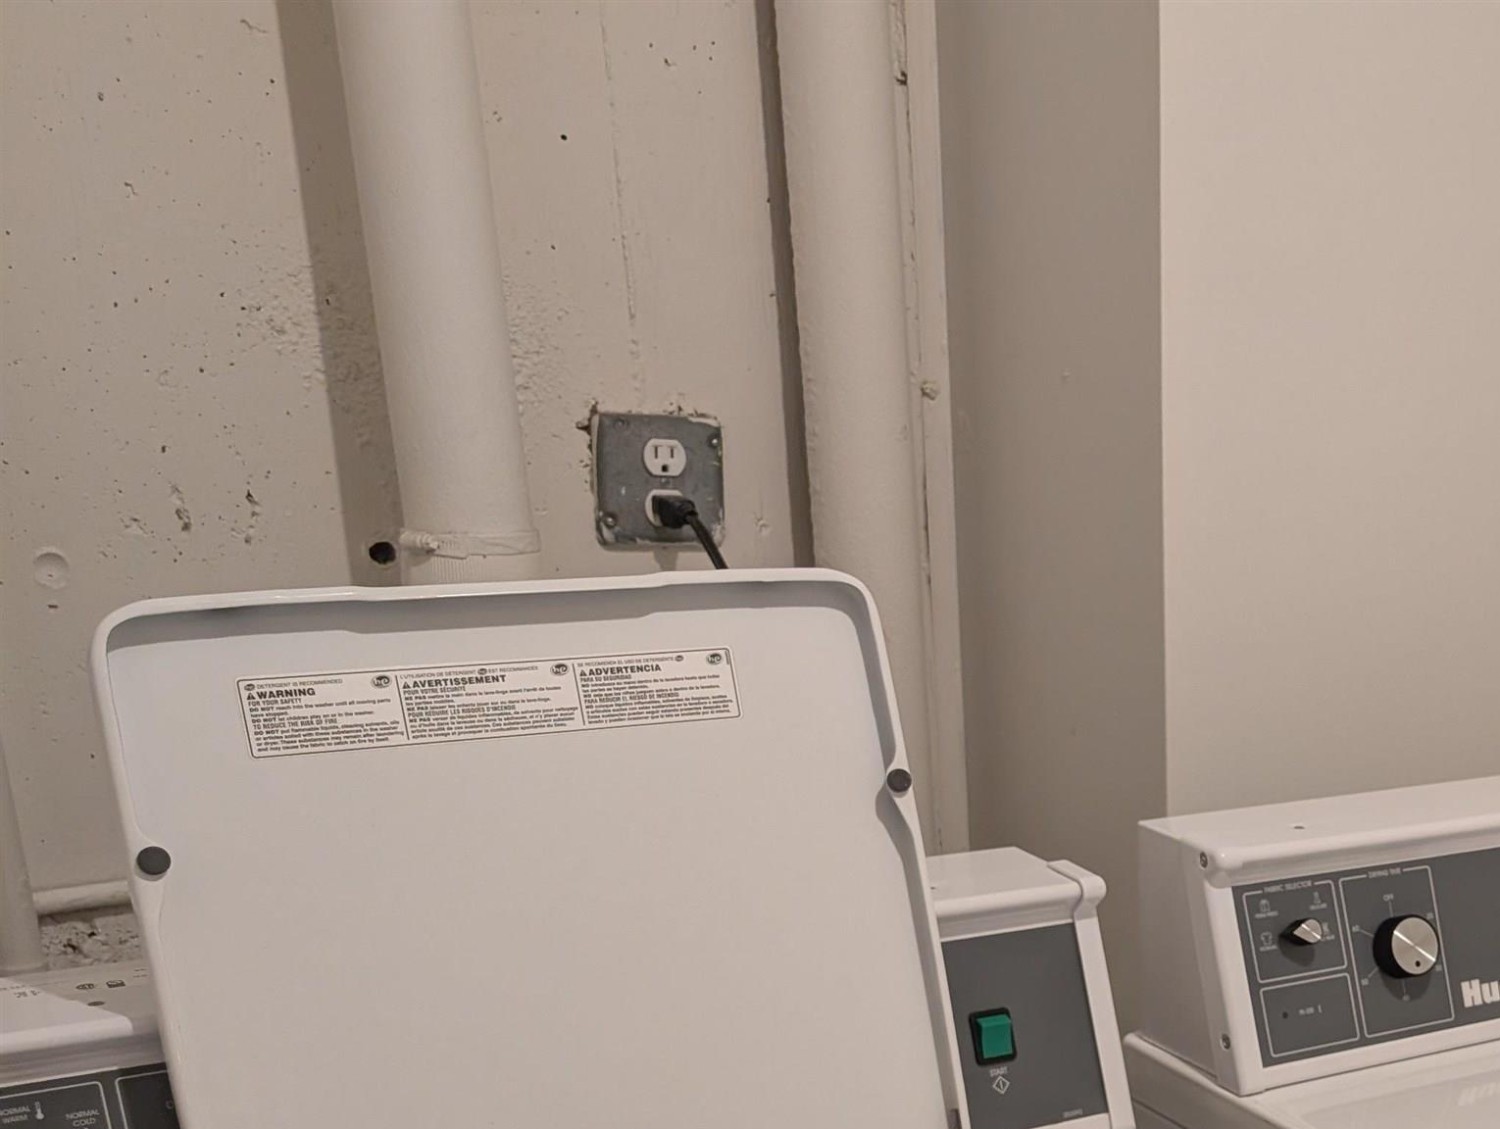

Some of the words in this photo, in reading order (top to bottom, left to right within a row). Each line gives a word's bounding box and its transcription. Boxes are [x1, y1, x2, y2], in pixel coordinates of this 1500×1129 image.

[588, 664, 661, 675] ADVERTENCIA
[412, 674, 506, 688] AVERTISSEMENT
[256, 687, 315, 699] WARNING
[65, 1108, 101, 1119] NORMAL
[72, 1117, 97, 1128] COLD
